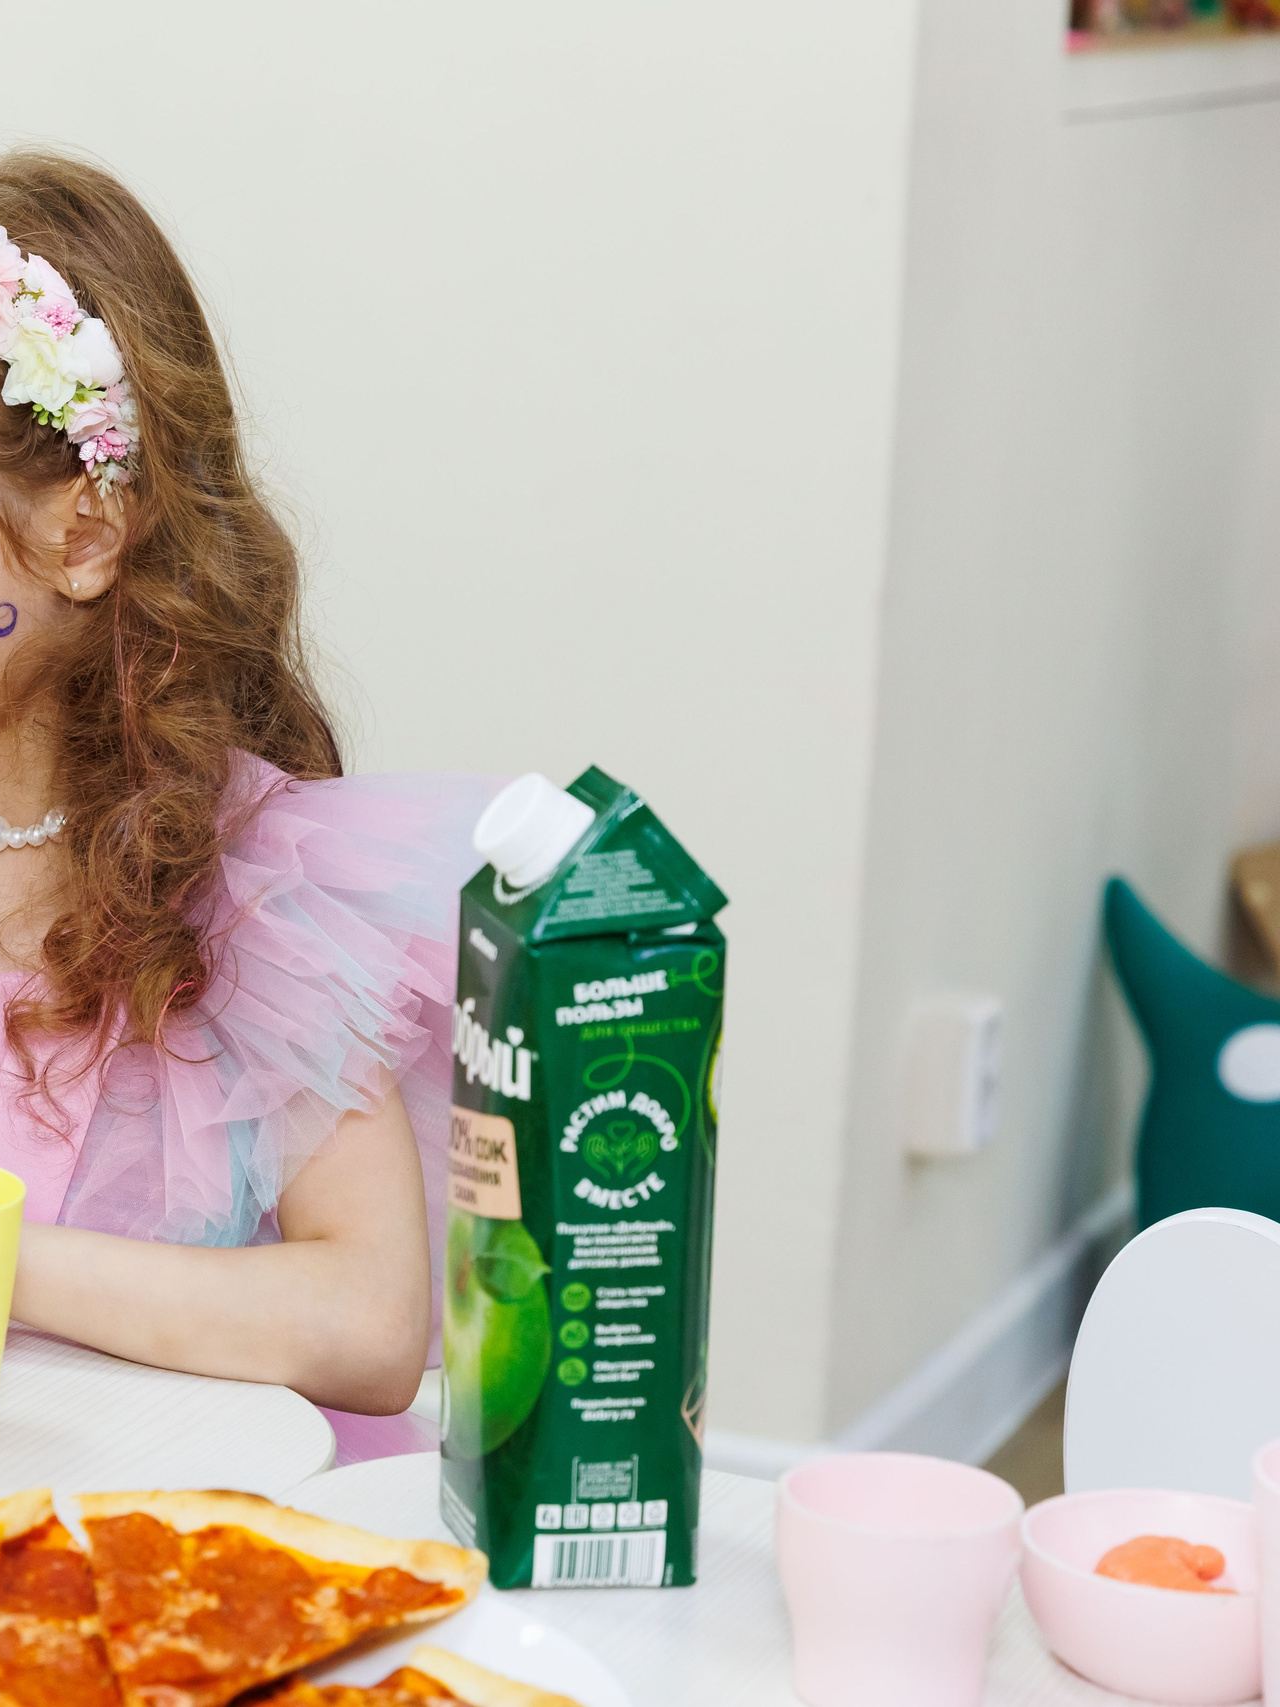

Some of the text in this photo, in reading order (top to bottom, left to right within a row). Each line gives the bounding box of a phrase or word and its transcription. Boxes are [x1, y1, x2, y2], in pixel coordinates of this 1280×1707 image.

[573, 969, 669, 1004] БОЛЬШЕ
[555, 996, 644, 1027] ПОЛЬЗЫ
[559, 1089, 679, 1153] РАСТИМ ДОБРО
[573, 1171, 666, 1211] ВМЕСТЕ
